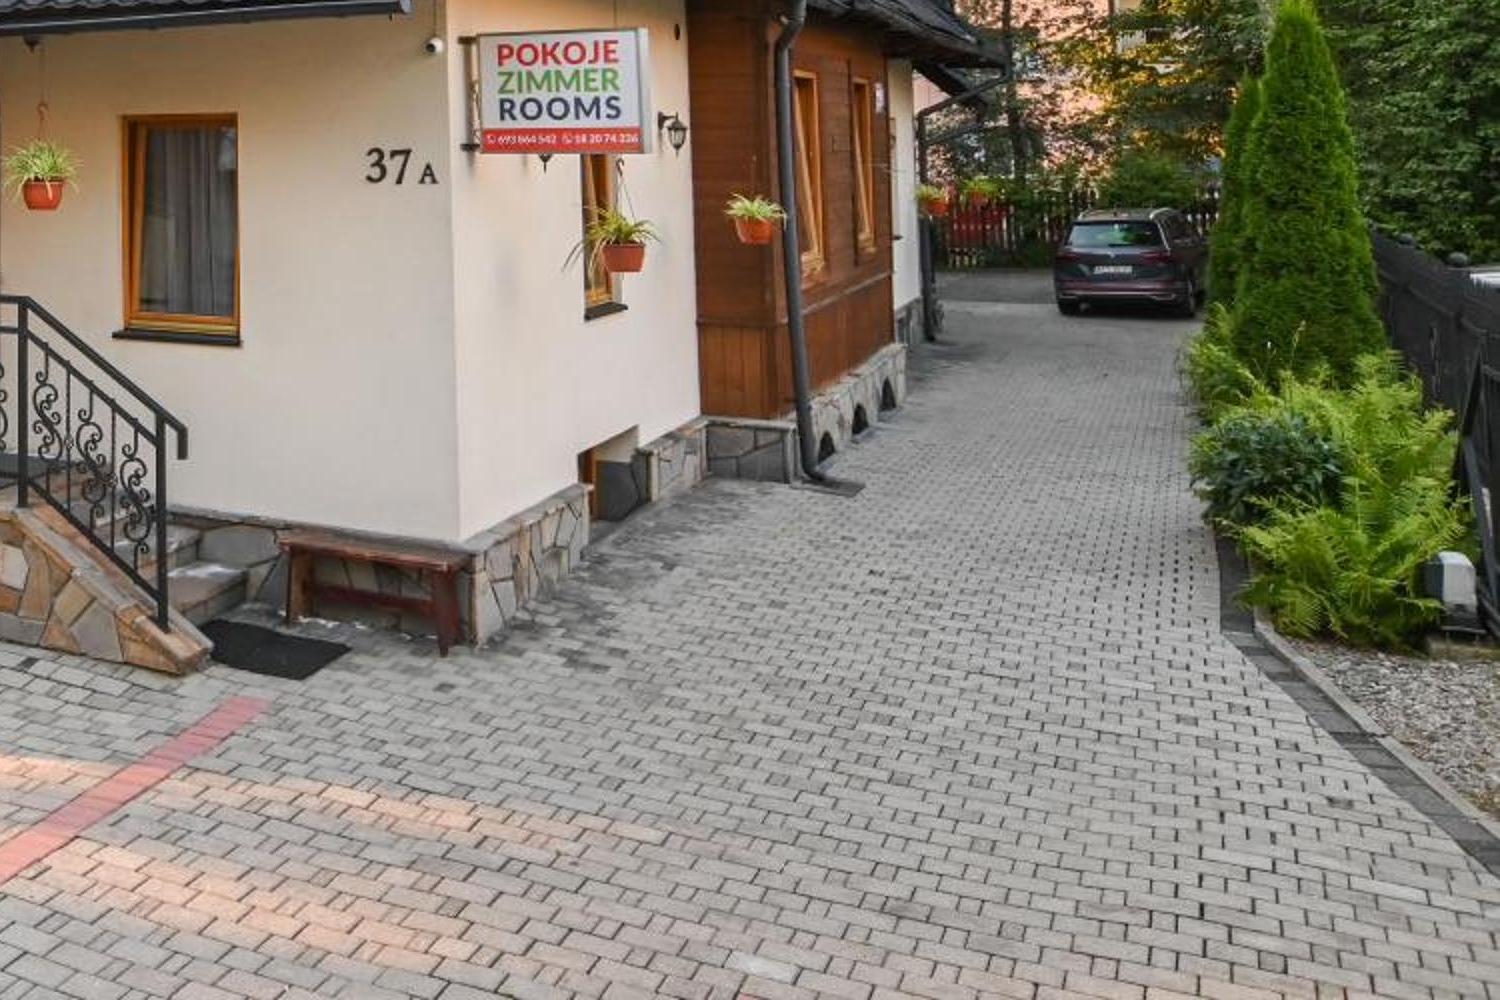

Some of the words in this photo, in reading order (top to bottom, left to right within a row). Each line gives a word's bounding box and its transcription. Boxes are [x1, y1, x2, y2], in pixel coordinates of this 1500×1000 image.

[496, 39, 620, 67] POKOJE
[497, 67, 621, 95] ZIMMER
[499, 95, 622, 121] ROOMS
